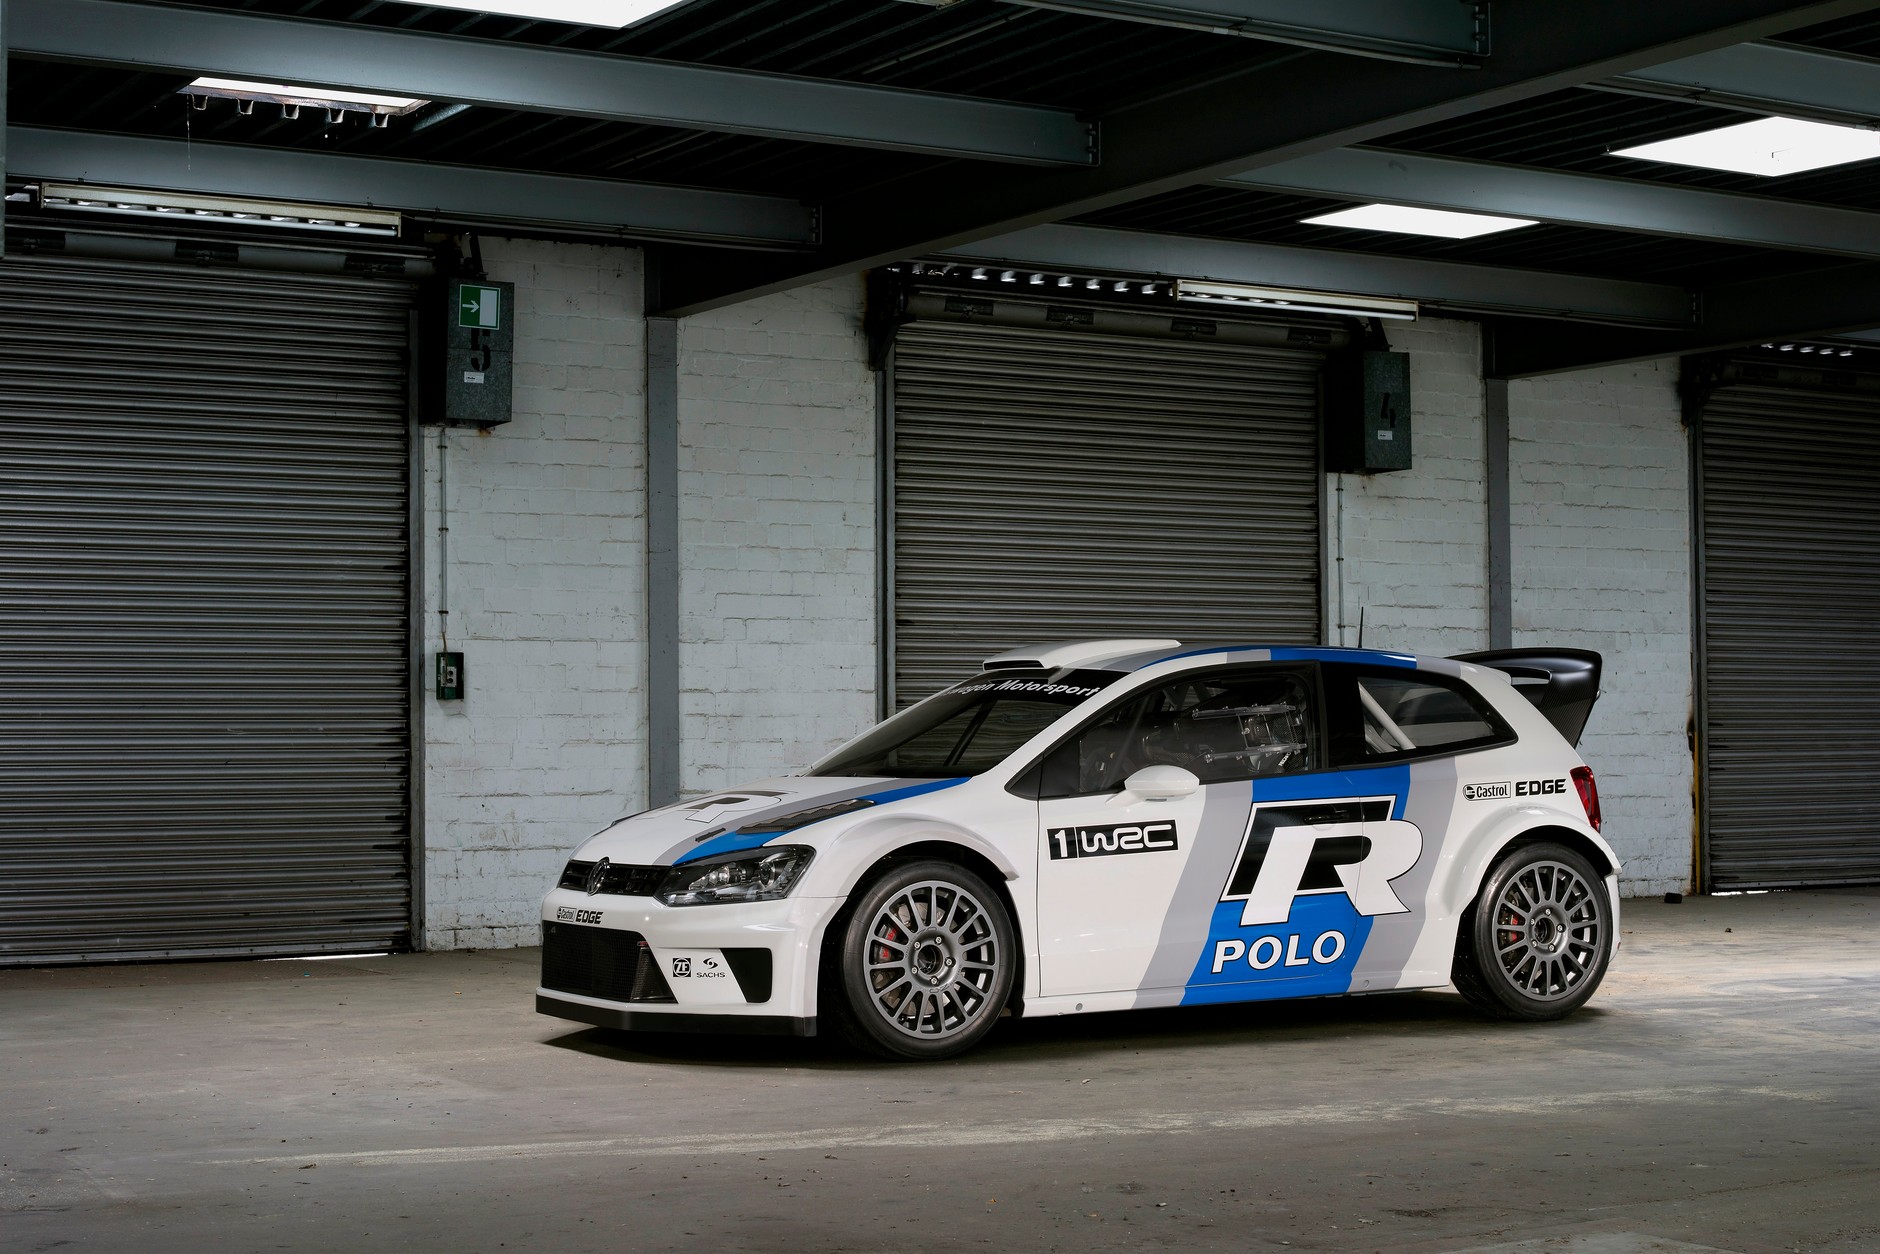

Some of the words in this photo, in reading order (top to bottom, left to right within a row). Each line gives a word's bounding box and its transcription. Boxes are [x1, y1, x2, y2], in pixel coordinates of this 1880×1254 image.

[470, 328, 491, 371] 5
[1380, 392, 1396, 428] 4
[993, 679, 1100, 696] Motorsport
[1476, 784, 1508, 798] Castrol
[1515, 779, 1567, 797] EDGE
[1054, 829, 1068, 858] 1
[1080, 824, 1174, 853] WRC
[1239, 818, 1424, 928] R
[575, 909, 604, 925] EDGE
[674, 961, 689, 974] ZF
[1211, 930, 1347, 974] POLO
